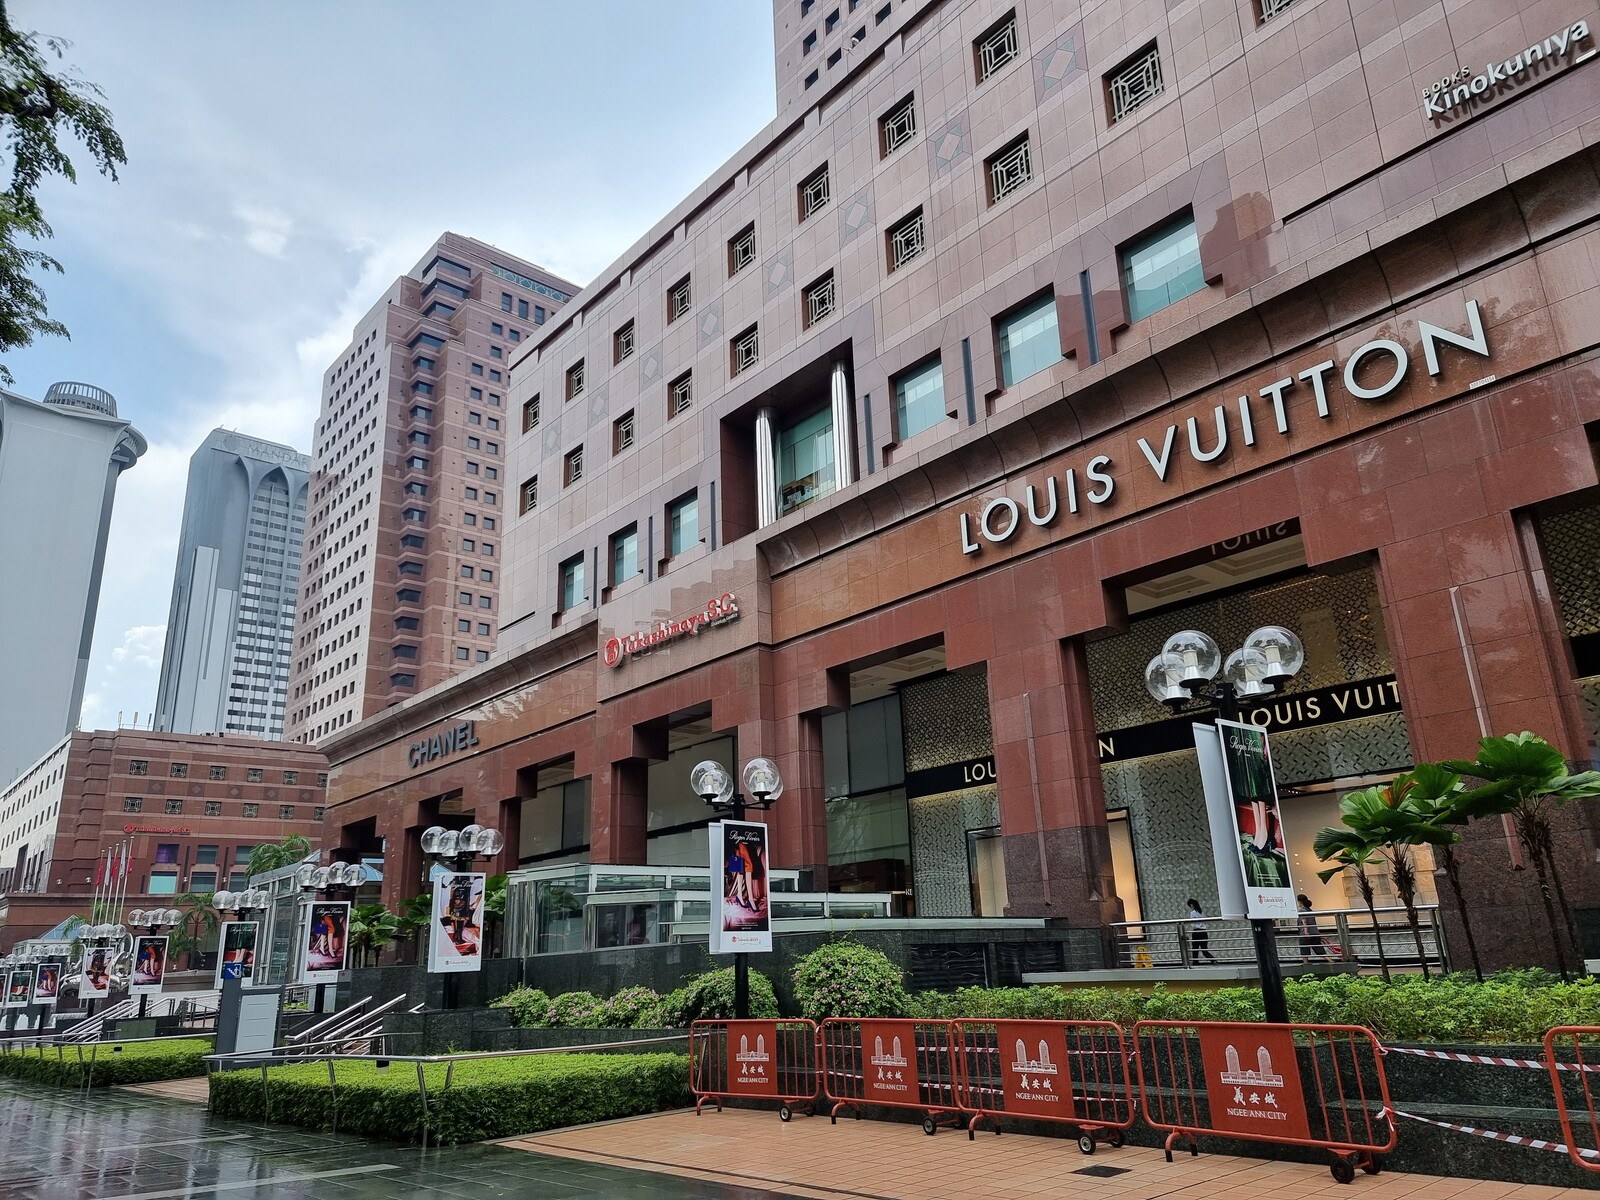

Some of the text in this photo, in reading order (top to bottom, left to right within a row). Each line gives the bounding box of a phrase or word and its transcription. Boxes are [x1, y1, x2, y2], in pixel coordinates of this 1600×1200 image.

[1422, 66, 1470, 99] BOOKS
[1424, 20, 1590, 119] Kinokuniya
[960, 299, 1491, 554] LOUIS VUITTON
[621, 592, 738, 655] Takashimaya S.C.
[408, 720, 478, 768] CHANEL
[1099, 737, 1115, 757] N
[1015, 1092, 1031, 1100] NGEE
[1044, 1094, 1059, 1102] CITY
[1227, 1107, 1288, 1121] NGEE ANN CITY
